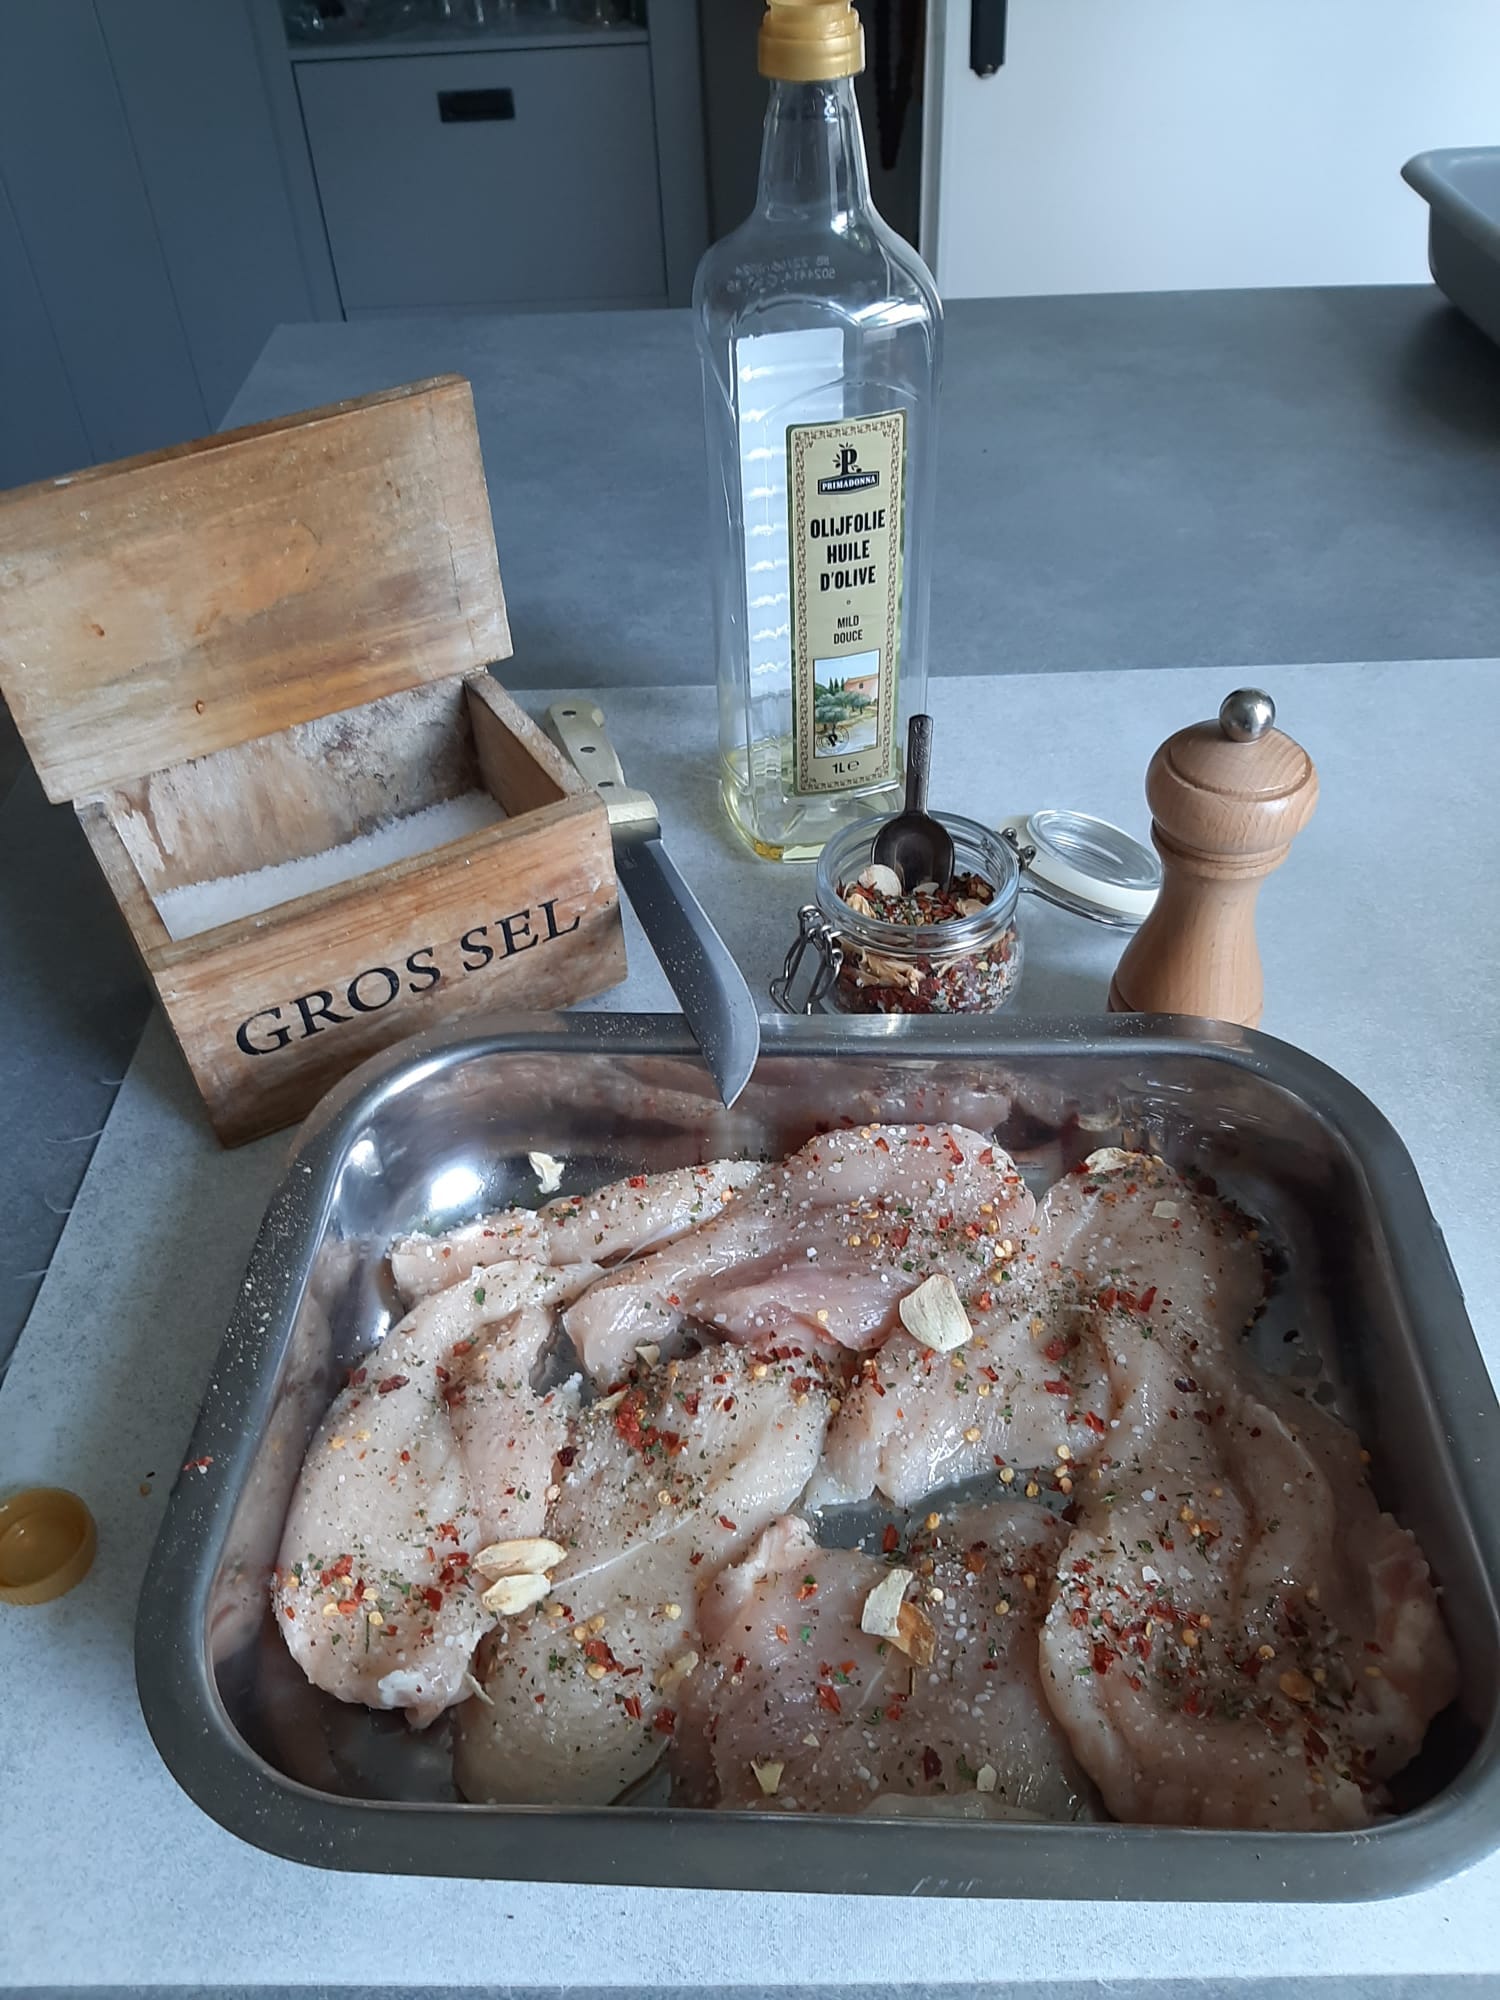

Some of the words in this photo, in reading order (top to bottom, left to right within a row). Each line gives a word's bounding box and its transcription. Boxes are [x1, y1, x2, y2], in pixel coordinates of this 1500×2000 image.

[821, 475, 876, 491] PRIMADONNA
[810, 509, 886, 539] OLIJFOLIE
[827, 540, 870, 564] HUILE
[820, 565, 876, 592] D'OLIVE
[837, 614, 860, 629] MILD
[833, 629, 863, 645] DOUCE
[235, 946, 441, 1057] GROS
[459, 898, 581, 973] SEL
